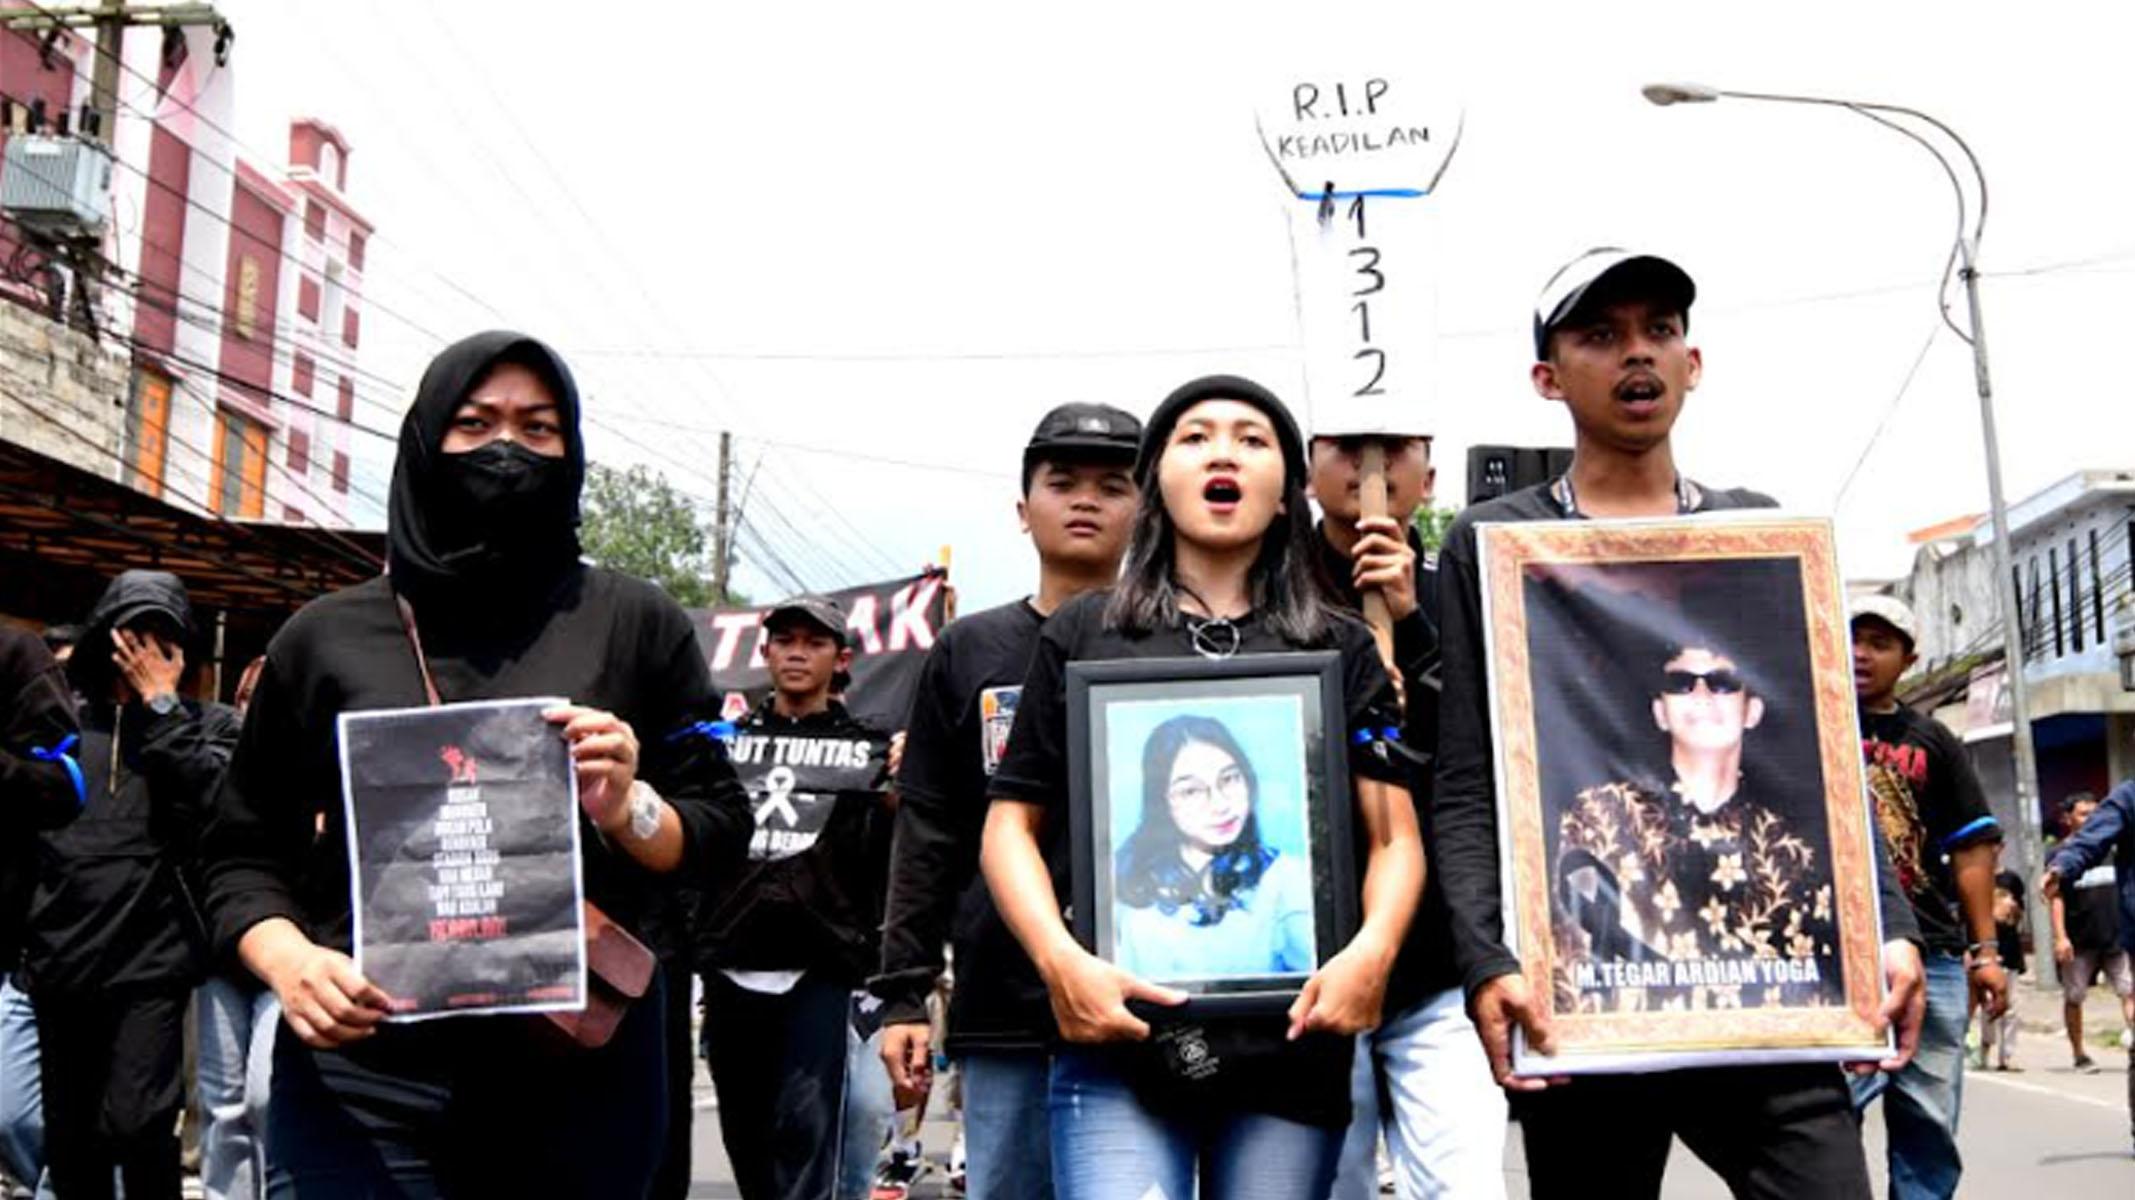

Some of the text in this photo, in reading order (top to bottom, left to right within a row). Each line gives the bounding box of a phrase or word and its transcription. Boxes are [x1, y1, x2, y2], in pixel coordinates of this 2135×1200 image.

[1292, 78, 1389, 121] R.I.P
[1278, 125, 1430, 159] KEADILAN
[773, 736, 872, 769] TUNTAS
[1674, 956, 1757, 985] ARDIAN
[1761, 955, 1820, 983] YOGA
